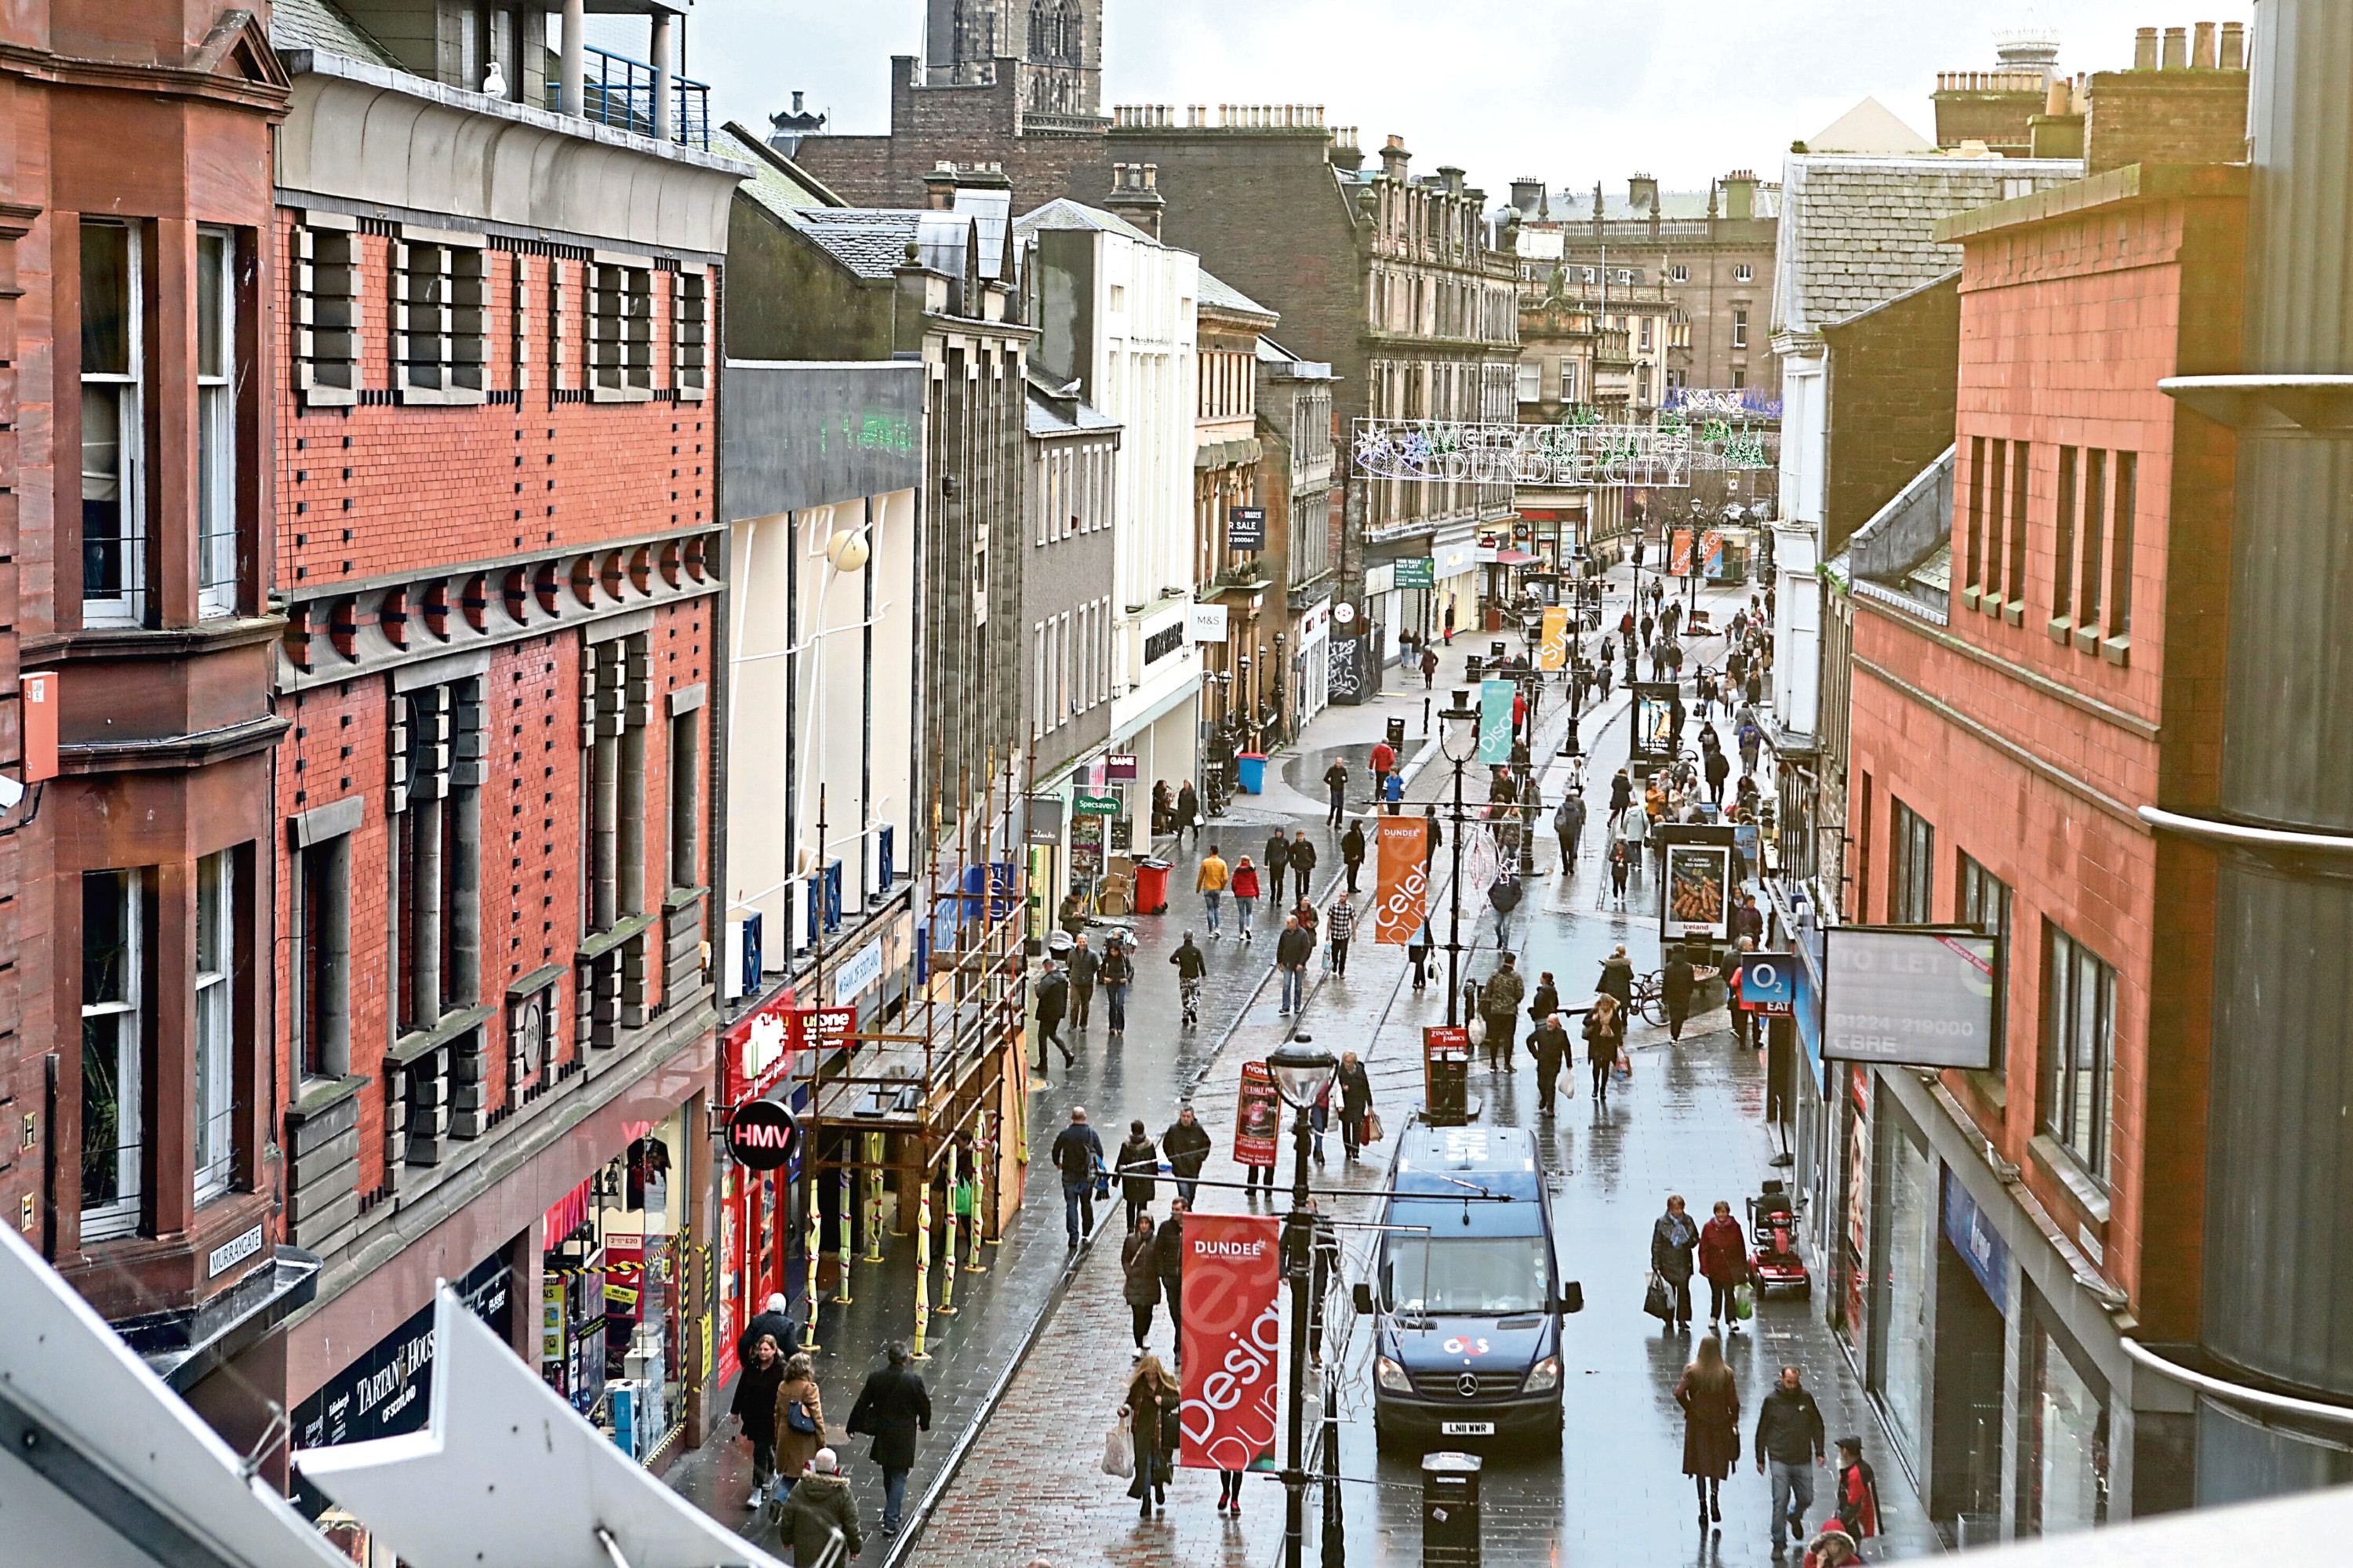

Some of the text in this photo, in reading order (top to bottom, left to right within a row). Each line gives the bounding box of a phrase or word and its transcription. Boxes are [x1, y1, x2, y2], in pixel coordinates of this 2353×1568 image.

[1533, 426, 1689, 453] Christmas
[1442, 451, 1685, 486] DUNDEE CITY
[1236, 522, 1257, 530] SALE
[1198, 617, 1220, 625] M&S
[1110, 757, 1134, 766] GAME
[1079, 799, 1117, 809] Specsavers
[1835, 948, 1944, 974] TO LET
[1944, 937, 1990, 973] Reduced Rent
[1767, 1002, 1791, 1011] EAT
[1834, 1013, 1974, 1037] 01224 219000
[1834, 1033, 1897, 1054] CBRE
[735, 1123, 791, 1148] HMV
[213, 1229, 260, 1272] MURRAYGATE
[1195, 1240, 1261, 1255] DUNDEE
[489, 1289, 506, 1311] RUGBY
[1444, 1336, 1489, 1355] G4S
[357, 1330, 435, 1416] TARTAN HOUS
[329, 1391, 350, 1417] Edinburgh
[382, 1385, 416, 1423] OF SCOTLAND
[1450, 1424, 1486, 1433] LN11 WWR
